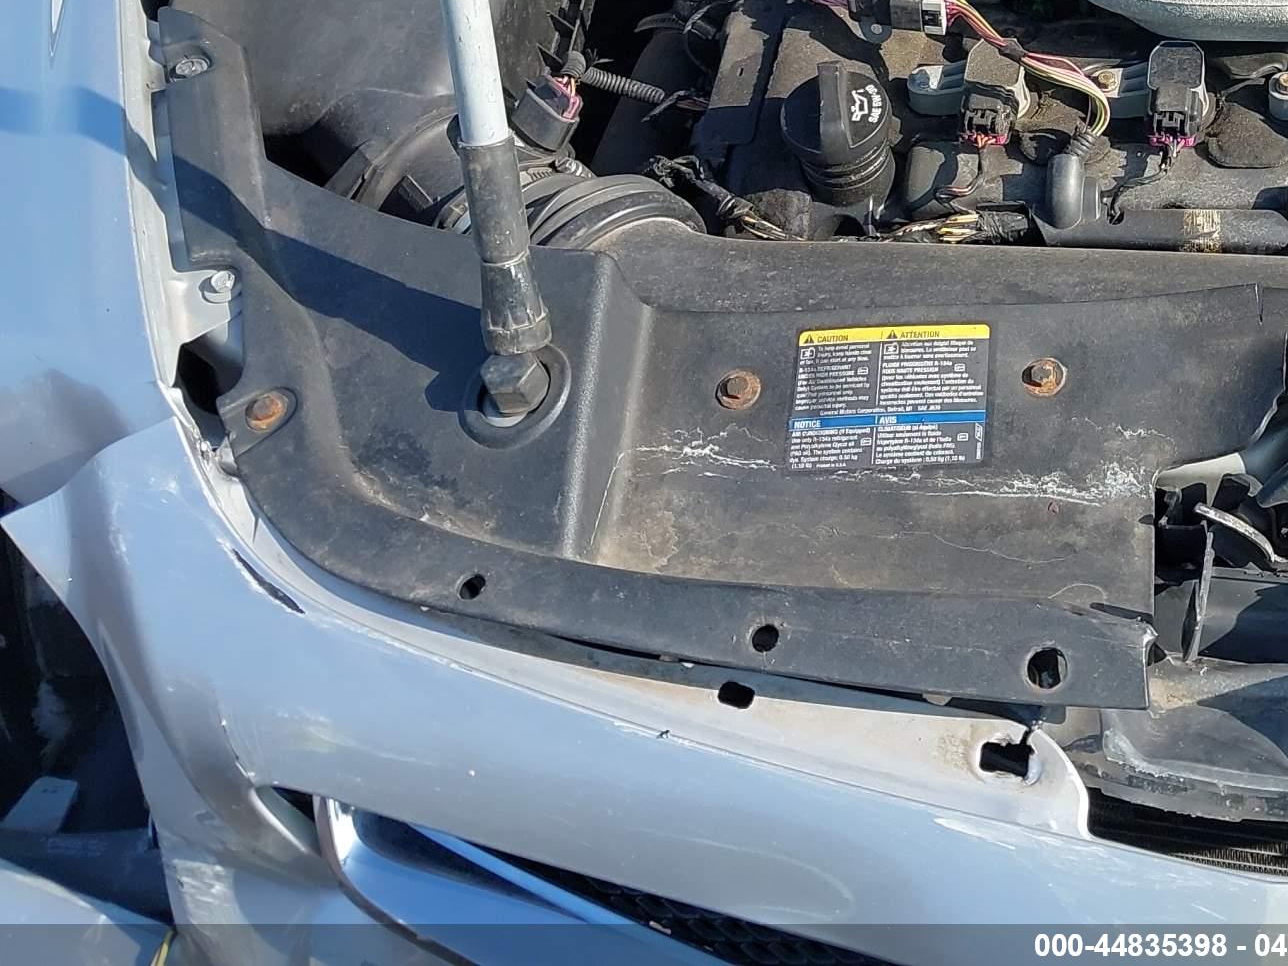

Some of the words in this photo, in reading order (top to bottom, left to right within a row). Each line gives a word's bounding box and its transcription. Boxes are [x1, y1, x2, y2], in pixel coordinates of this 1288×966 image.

[865, 85, 882, 106] 5W-30
[868, 107, 882, 123] SAE
[794, 420, 821, 428] NOTICE
